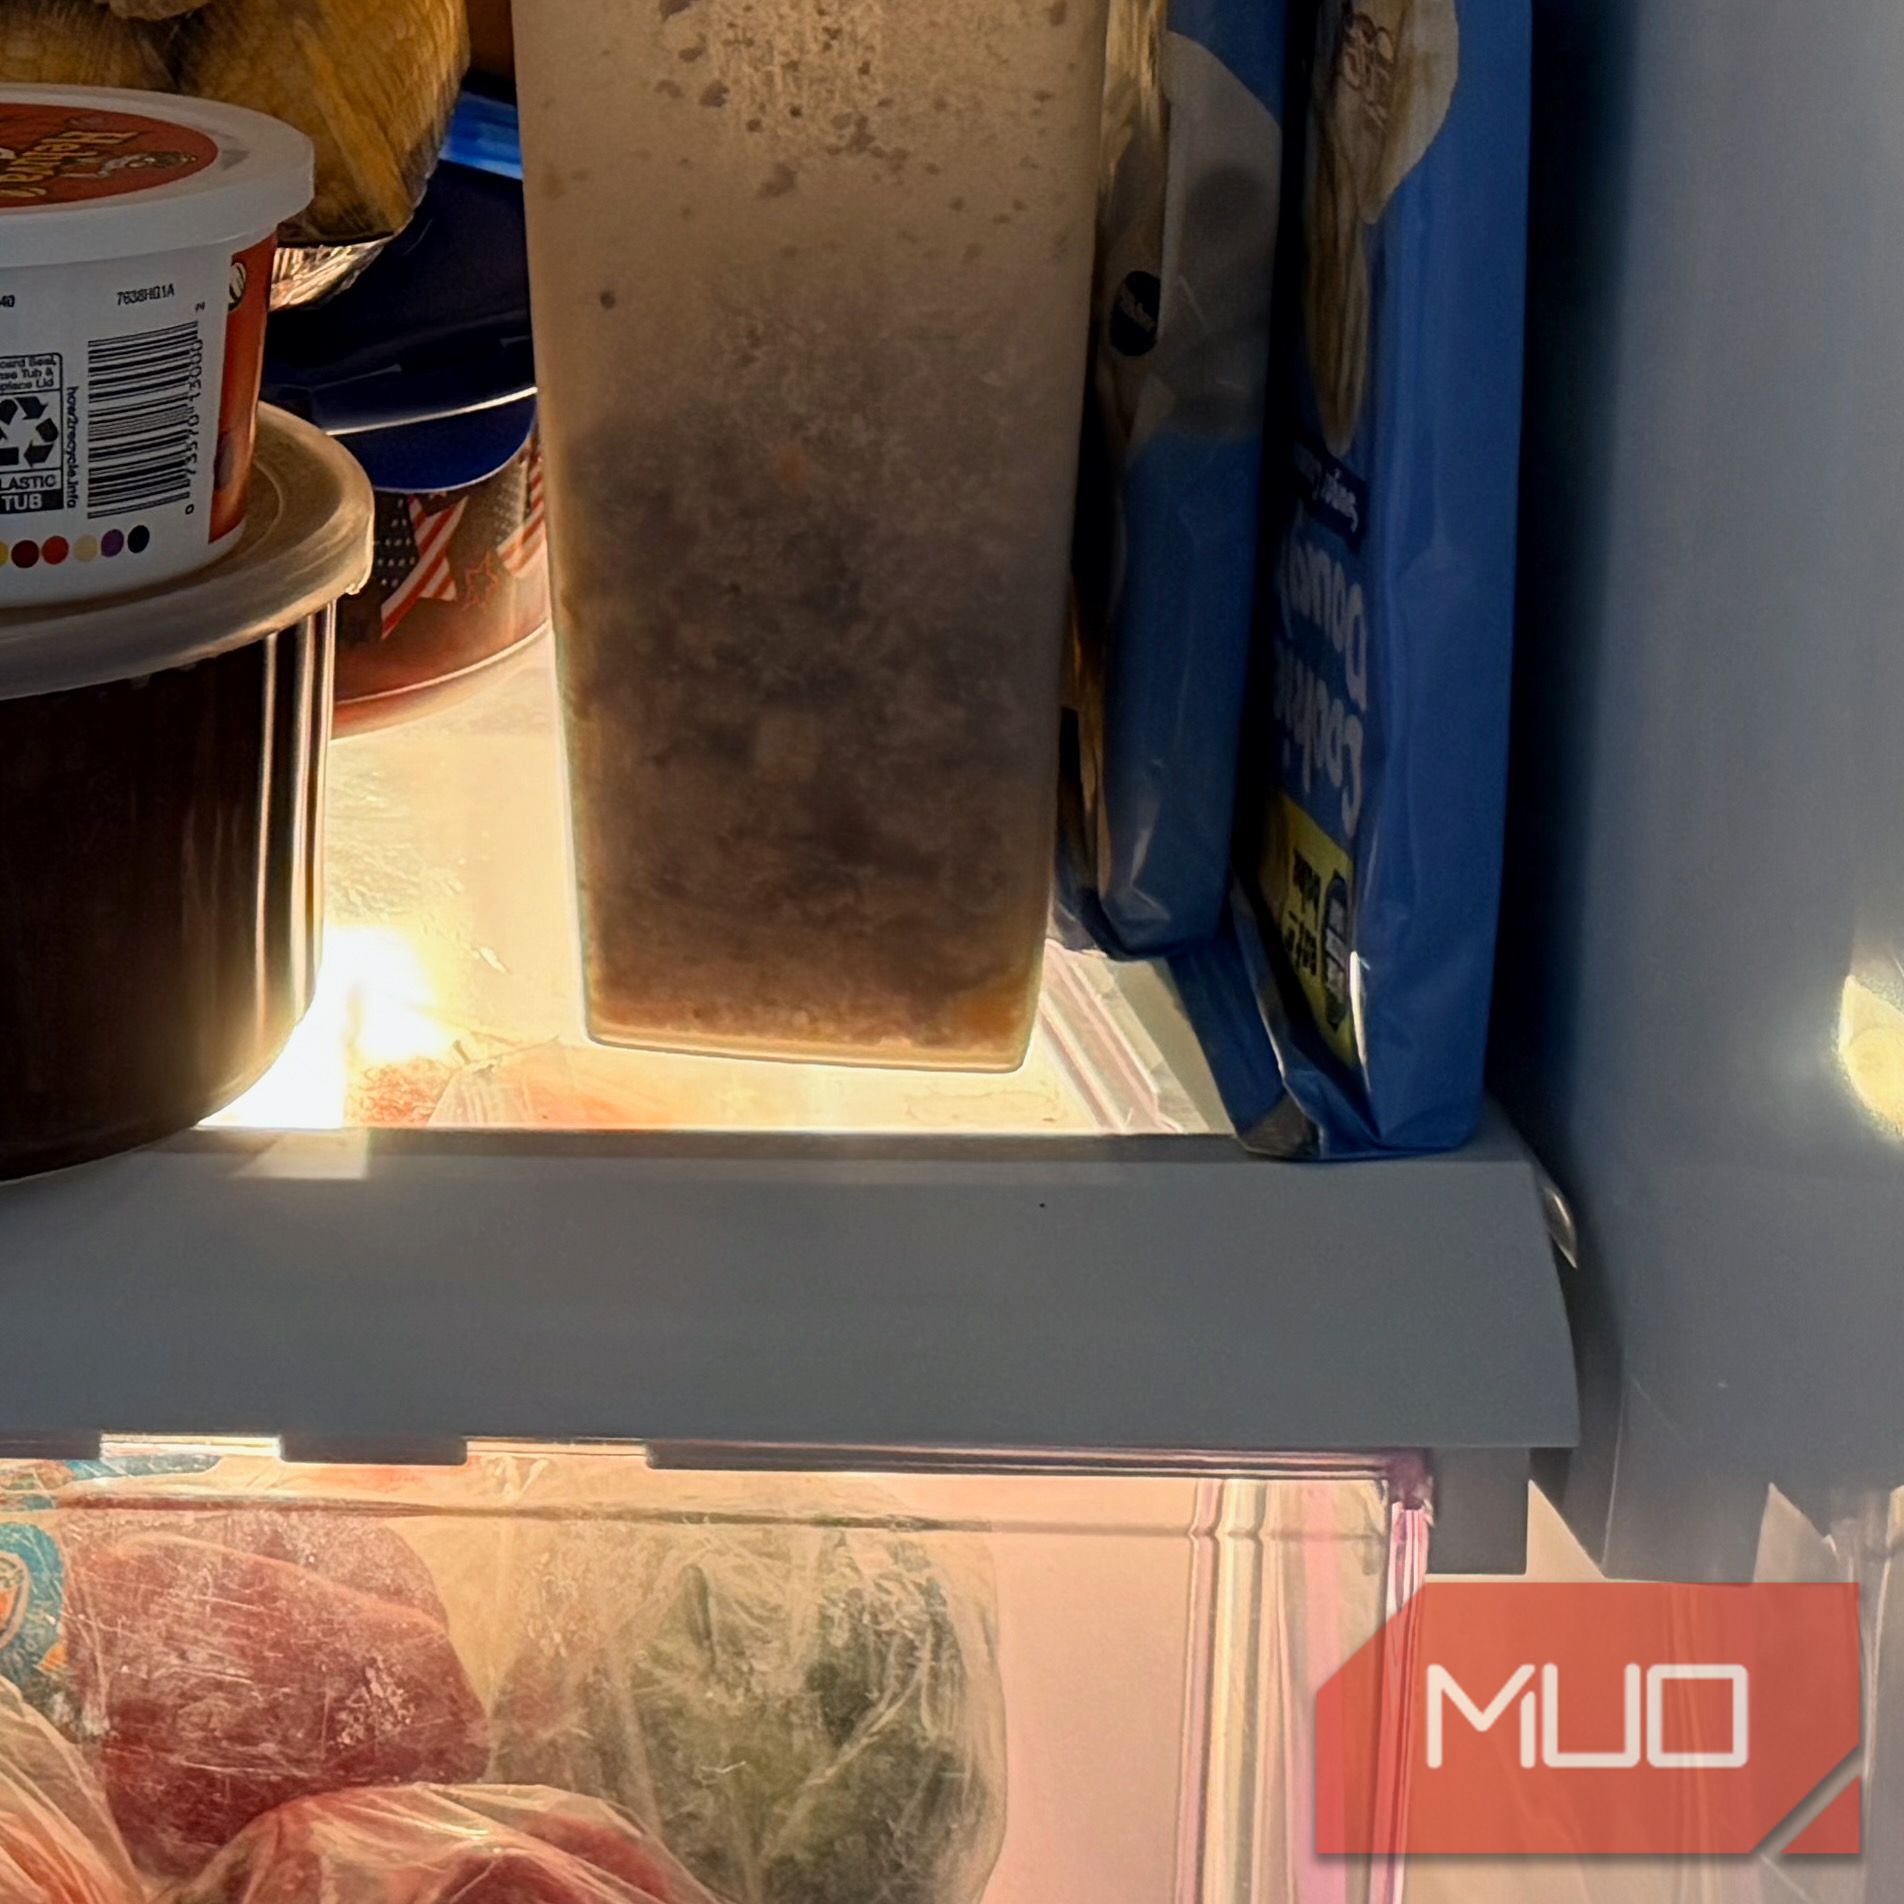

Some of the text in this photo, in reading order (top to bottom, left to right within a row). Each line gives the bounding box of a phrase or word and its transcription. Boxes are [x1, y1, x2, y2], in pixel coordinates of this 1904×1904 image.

[22, 369, 42, 378] Tub
[35, 379, 54, 387] Lid
[67, 386, 79, 508] how2recycle.info
[1, 495, 42, 511] TUB
